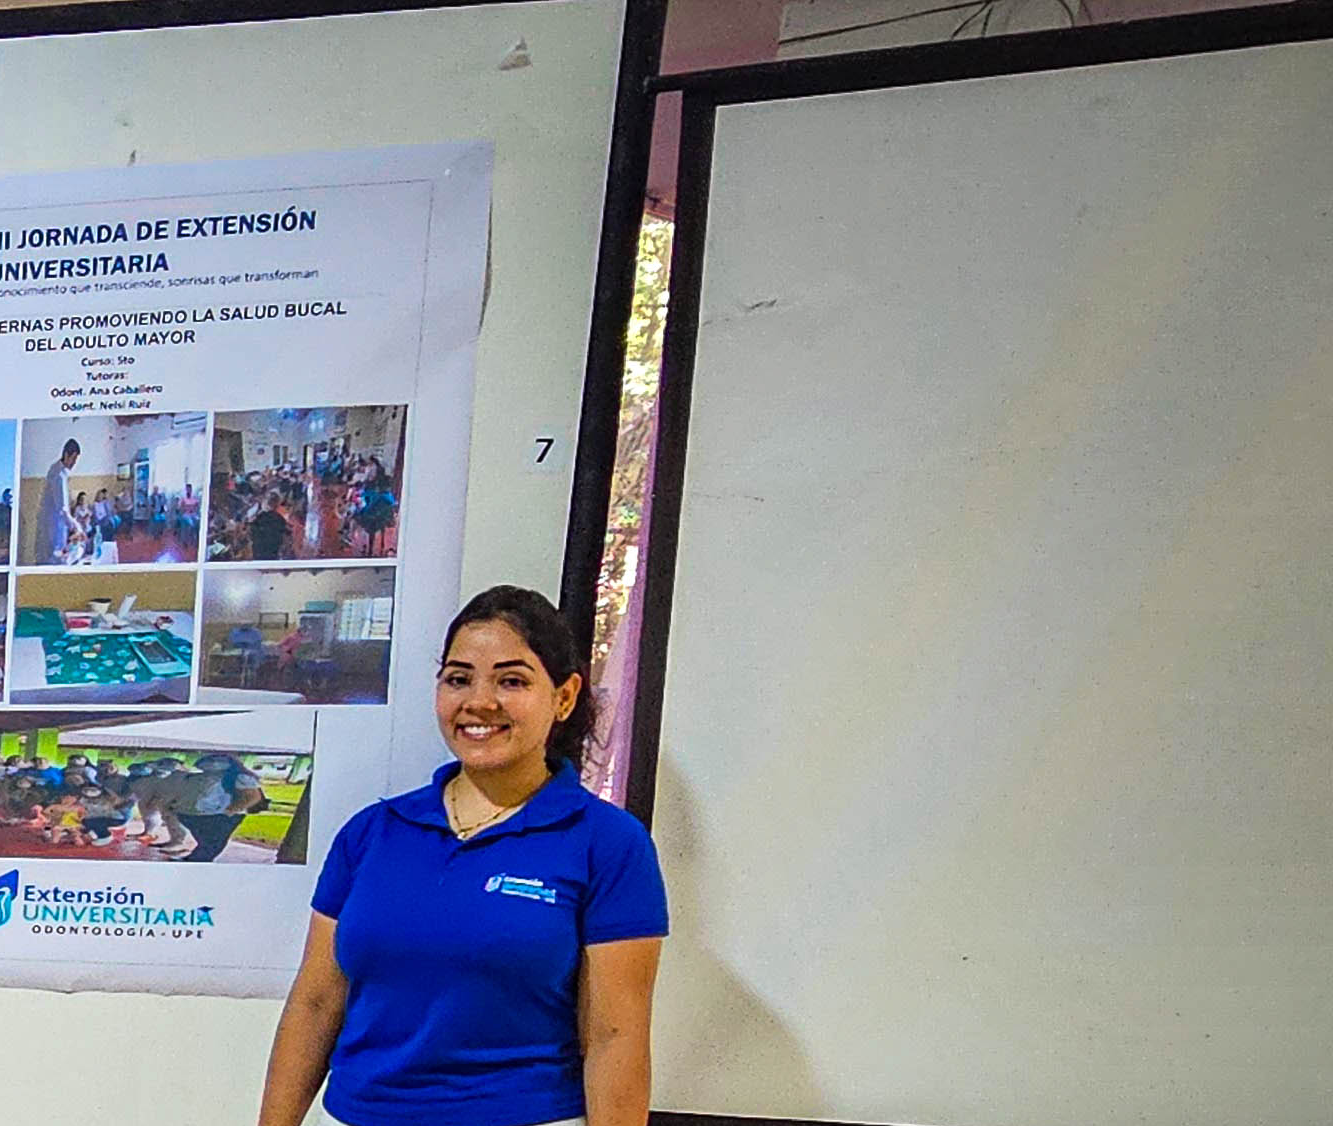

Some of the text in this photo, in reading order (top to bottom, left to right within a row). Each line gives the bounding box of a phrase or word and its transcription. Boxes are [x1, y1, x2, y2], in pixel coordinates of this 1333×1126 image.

[17, 223, 129, 250] JORNADA
[136, 220, 169, 241] DE
[176, 206, 317, 239] EXTENSIÓN
[70, 284, 91, 296] que
[167, 275, 215, 287] sonrisas
[219, 273, 241, 285] que
[244, 269, 319, 282] transforman
[59, 310, 187, 333] PROMOVIENDO
[192, 308, 215, 323] LA
[219, 304, 279, 322] SALUD
[284, 301, 347, 318] BUCAL
[25, 330, 196, 353] DEL ADULTO MAYOR
[81, 357, 115, 368] Curso:
[89, 385, 110, 396] Ana
[113, 384, 163, 396] Caballero
[535, 438, 555, 463] 7
[23, 885, 145, 905] Extensión
[23, 904, 214, 926] UNIVERSITARIA
[32, 925, 156, 938] ODONTOLOGÍA
[172, 930, 204, 939] UPE
